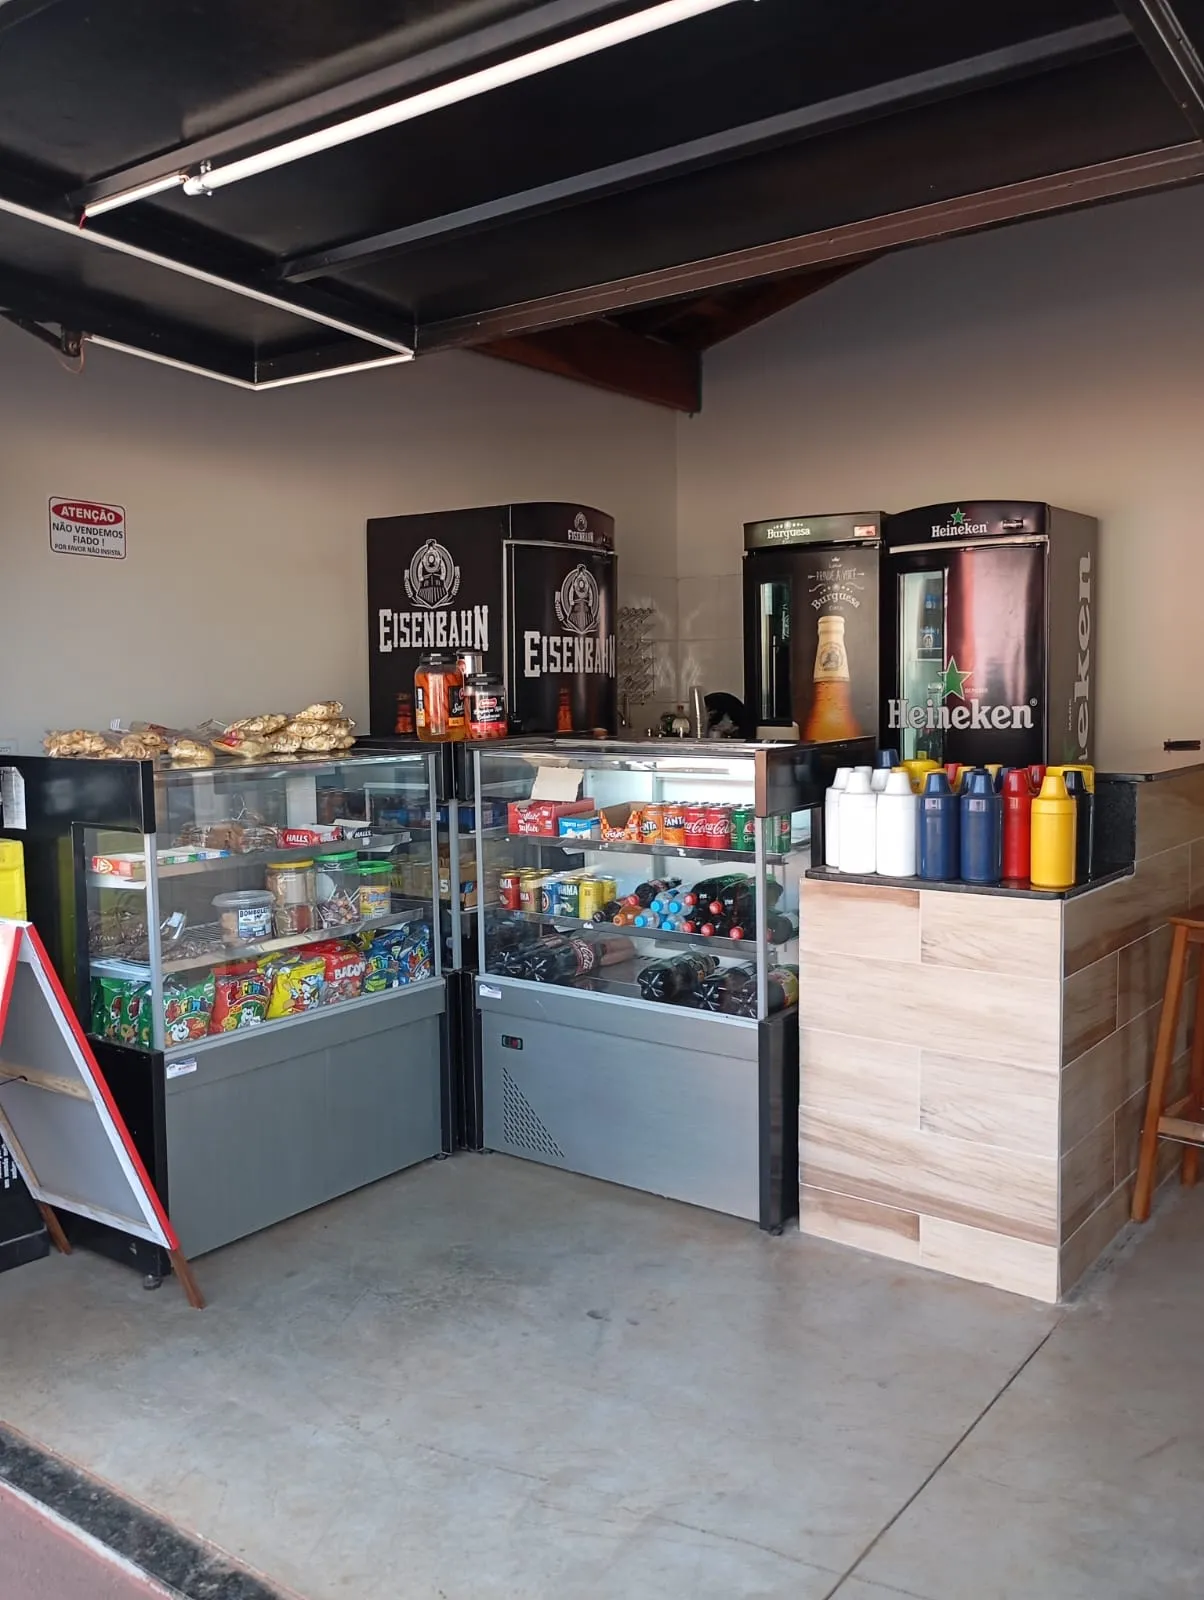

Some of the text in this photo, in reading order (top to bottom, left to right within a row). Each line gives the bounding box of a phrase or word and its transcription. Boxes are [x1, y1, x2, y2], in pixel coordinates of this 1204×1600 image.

[60, 505, 115, 523] ATENÇÃO
[52, 521, 123, 539] NÃO VENDEMOS
[766, 527, 811, 540] Burguesa
[931, 522, 988, 538] Heineken
[67, 544, 86, 552] FAVOR
[87, 546, 100, 554] NÃO
[72, 535, 100, 546] FIADO
[811, 592, 860, 611] Burguesa
[379, 605, 489, 653] EISENBAHN
[887, 699, 1034, 730] Heineken
[286, 833, 309, 843] HALLS
[354, 830, 372, 839] HALLS
[334, 961, 366, 980] BACON
